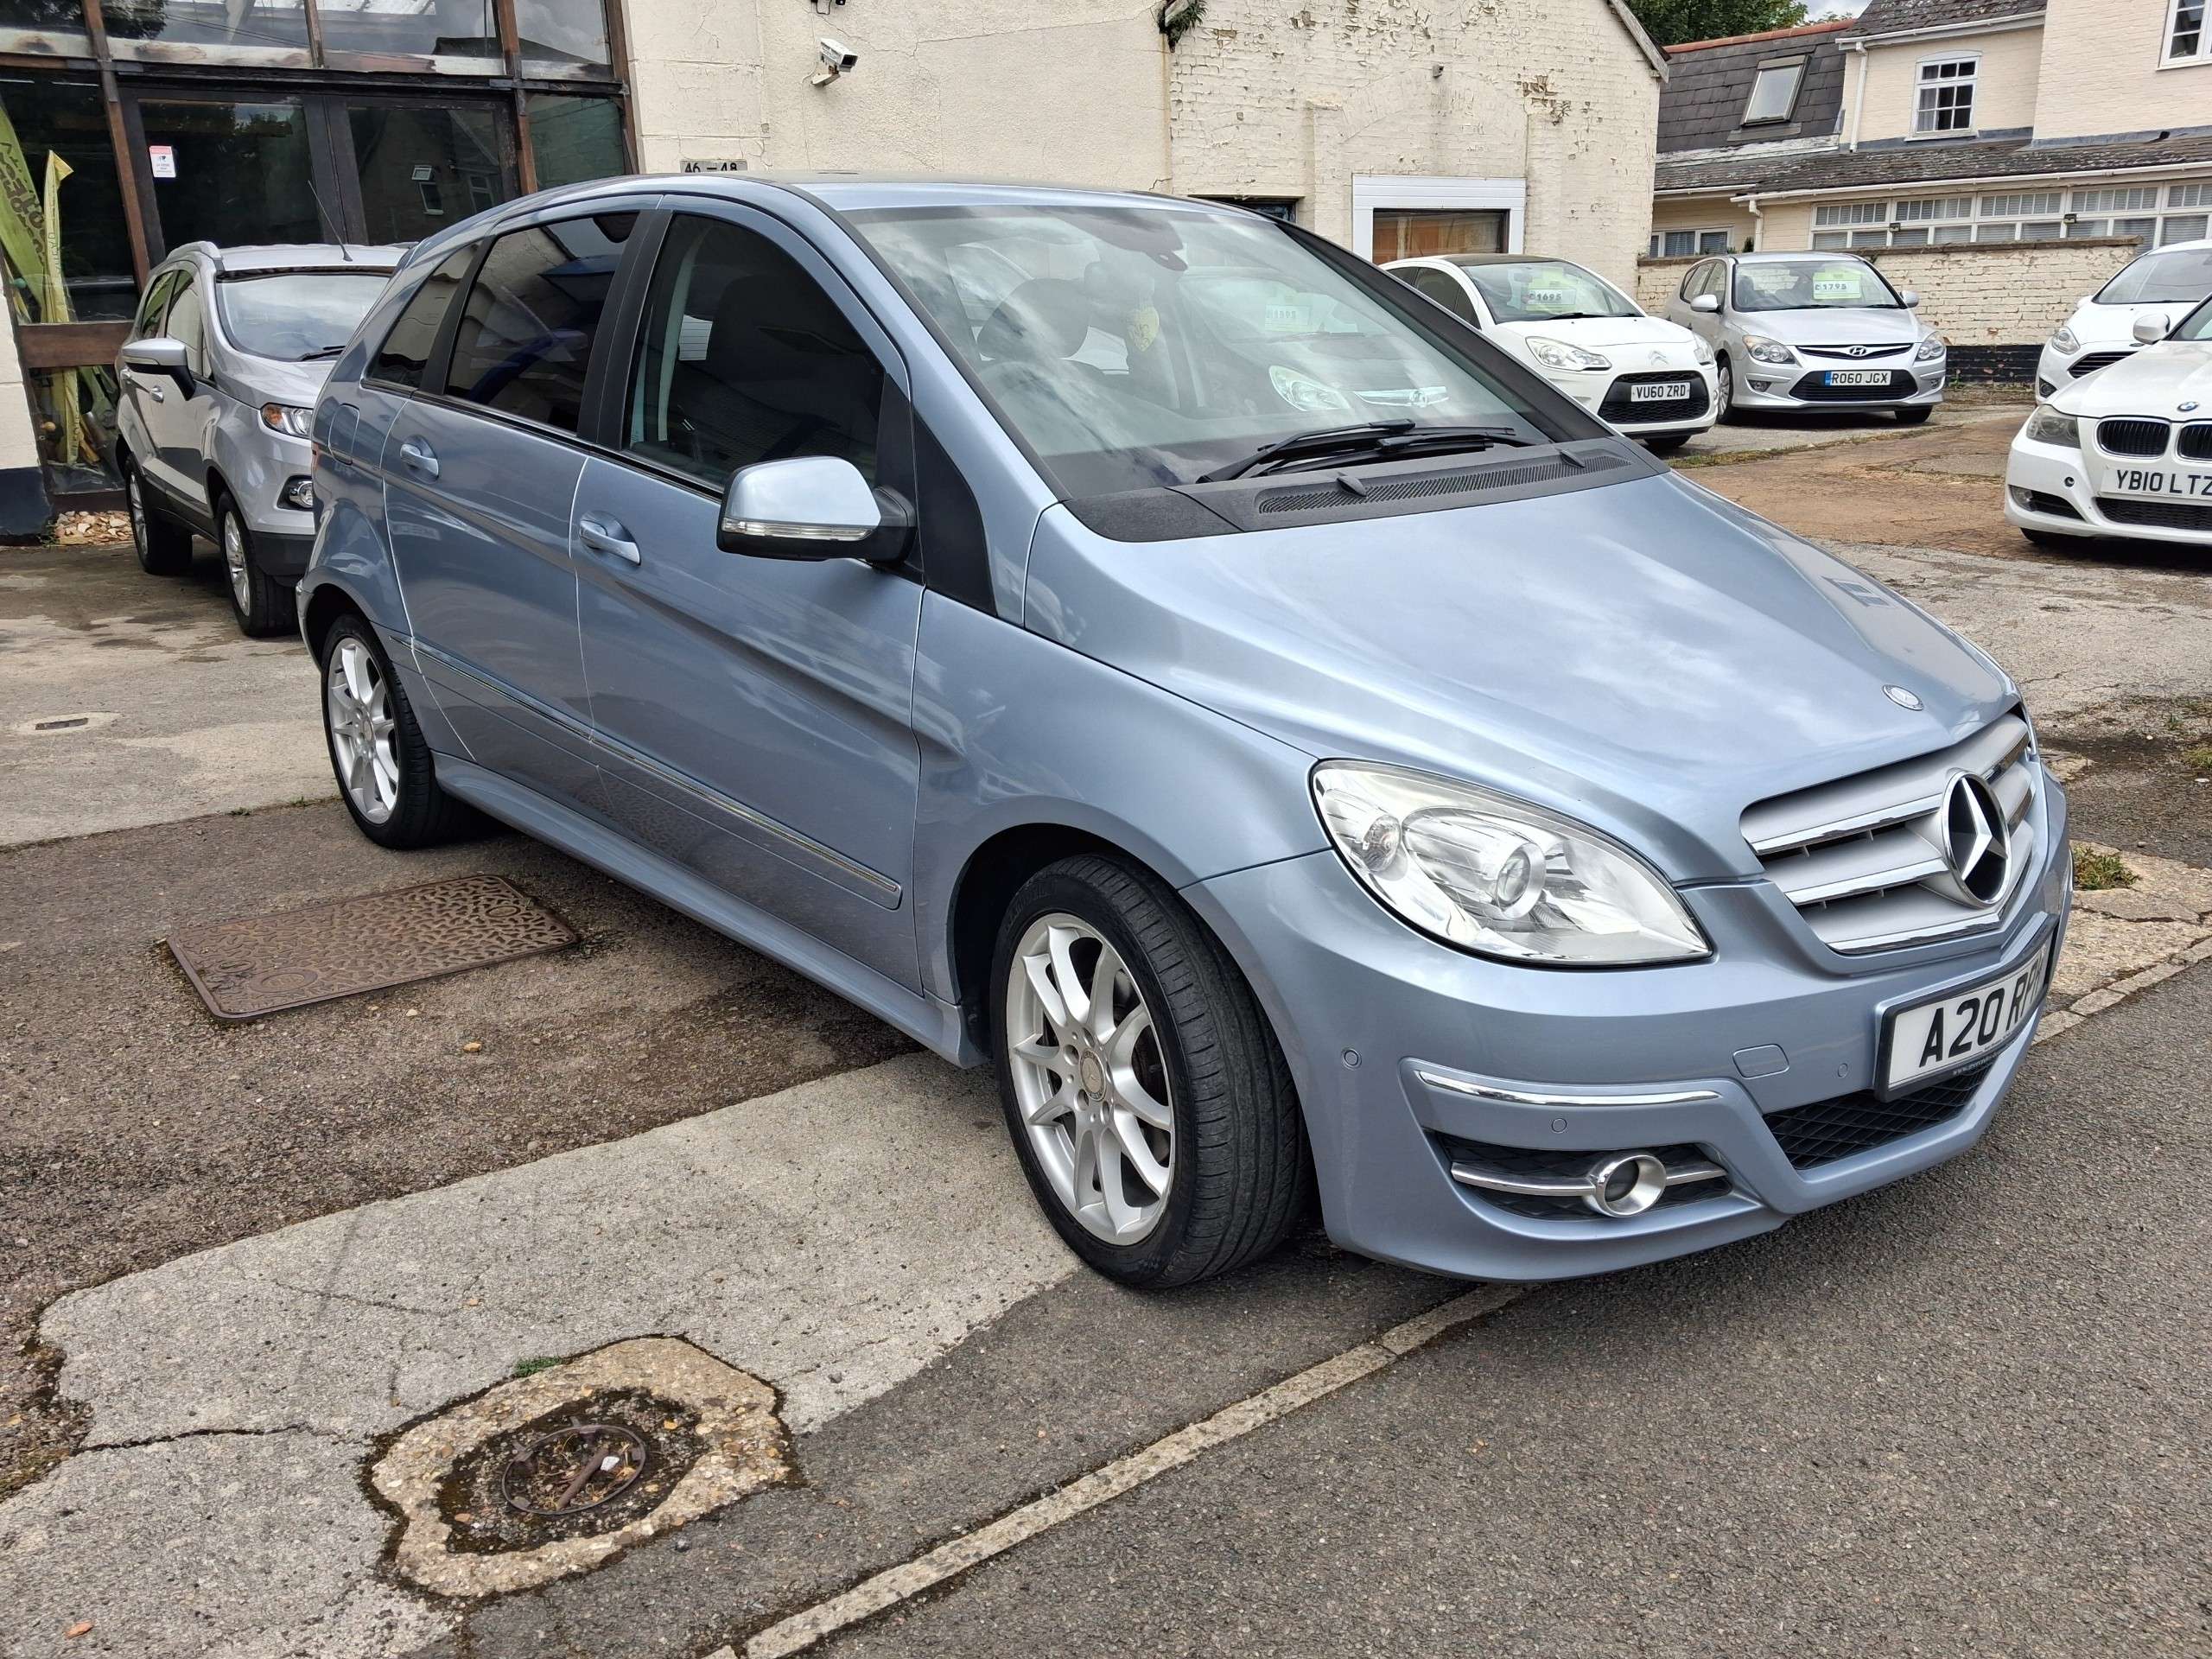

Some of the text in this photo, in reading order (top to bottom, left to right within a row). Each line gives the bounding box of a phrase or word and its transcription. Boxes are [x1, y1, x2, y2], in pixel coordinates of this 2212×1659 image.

[684, 162, 701, 173] 46
[721, 162, 737, 171] 48
[1832, 372, 1887, 384] RO60 JGX
[1637, 385, 1686, 398] VU60 ZRD
[2117, 469, 2212, 496] YB10 LTZ
[1919, 988, 2005, 1068] A20
